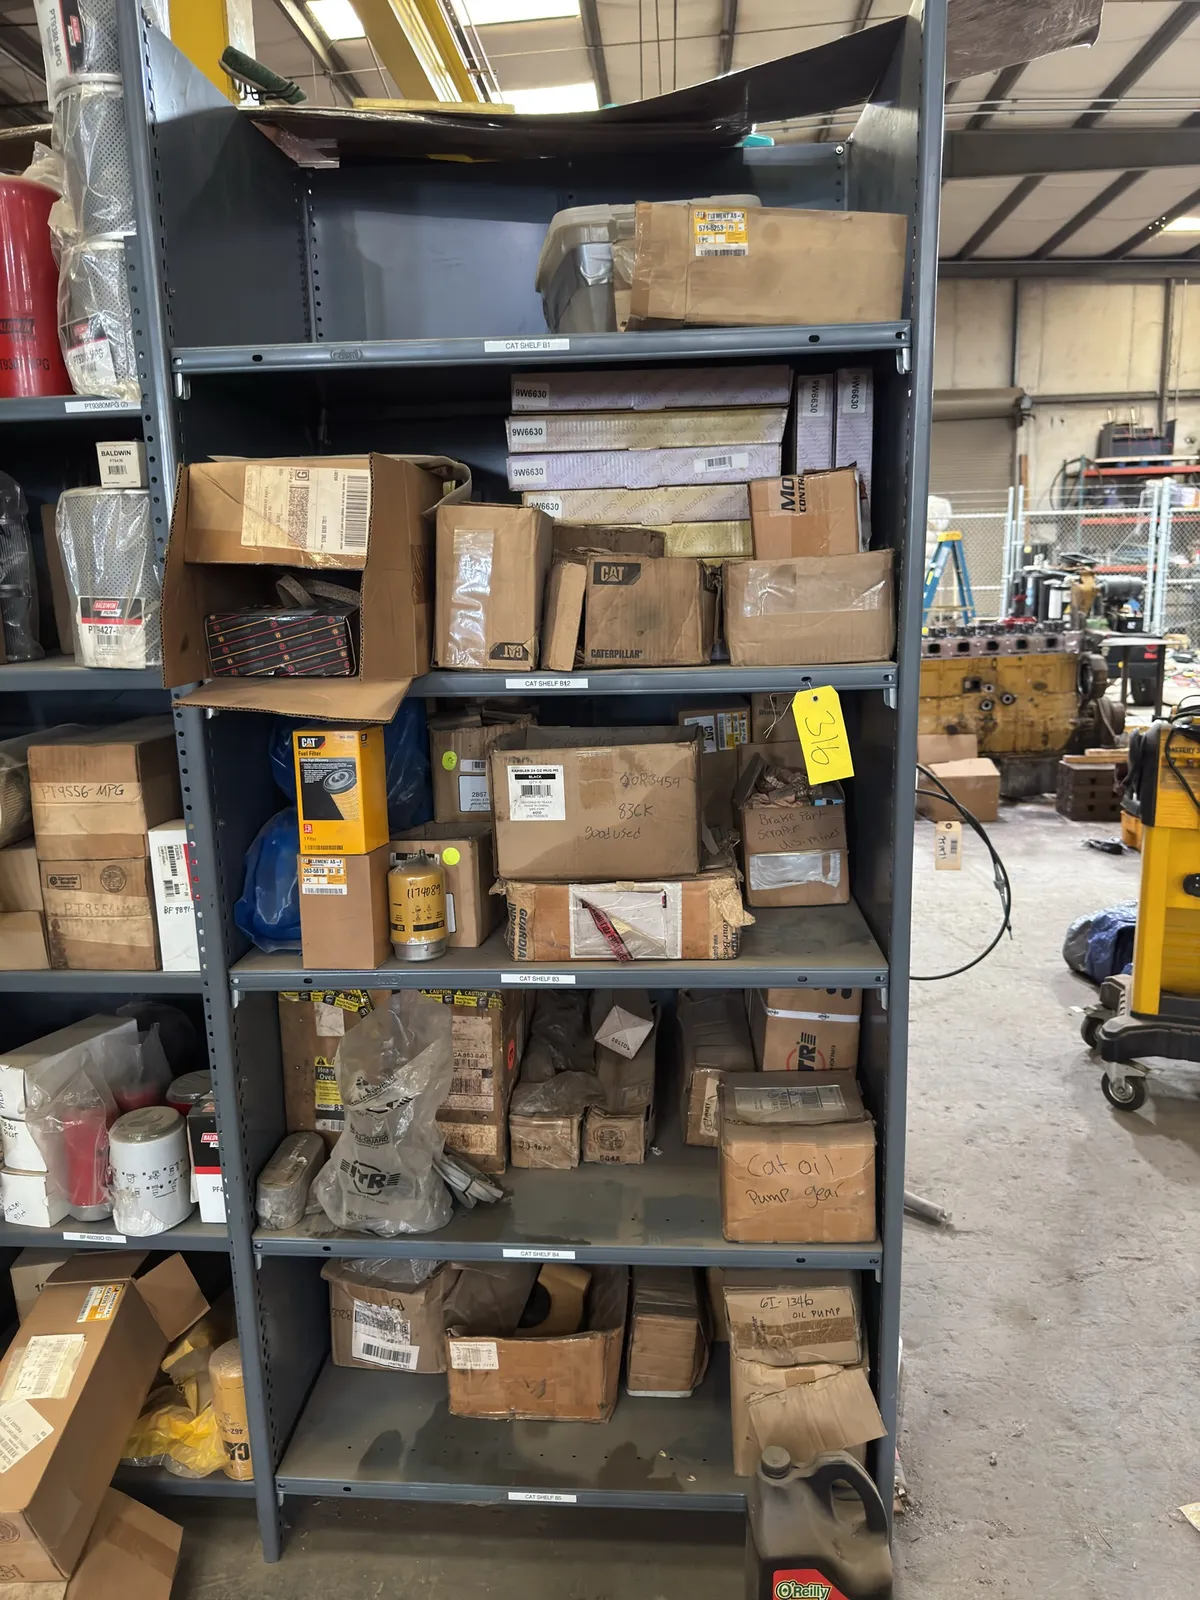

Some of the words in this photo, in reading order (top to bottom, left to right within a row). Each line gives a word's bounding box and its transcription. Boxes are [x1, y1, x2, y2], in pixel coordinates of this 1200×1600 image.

[515, 388, 547, 399] 9W6630
[512, 428, 543, 437] 9W6630
[514, 467, 544, 477] 9W6630
[798, 476, 808, 512] CONTR
[600, 566, 625, 582] CAT
[503, 645, 523, 658] CAT
[591, 650, 642, 659] CATERPILLAR
[302, 738, 316, 748] CAT
[804, 710, 840, 766] 316
[584, 826, 611, 840] good
[407, 884, 441, 899] 1174089
[518, 908, 528, 961] GUARDIA
[797, 1044, 816, 1071] TR
[746, 1154, 788, 1178] Cat
[798, 1154, 834, 1176] oil
[804, 1182, 844, 1208] gear
[792, 1309, 806, 1318] OIL
[811, 1307, 840, 1318] PUMP
[776, 1580, 829, 1598] O'Reilly
